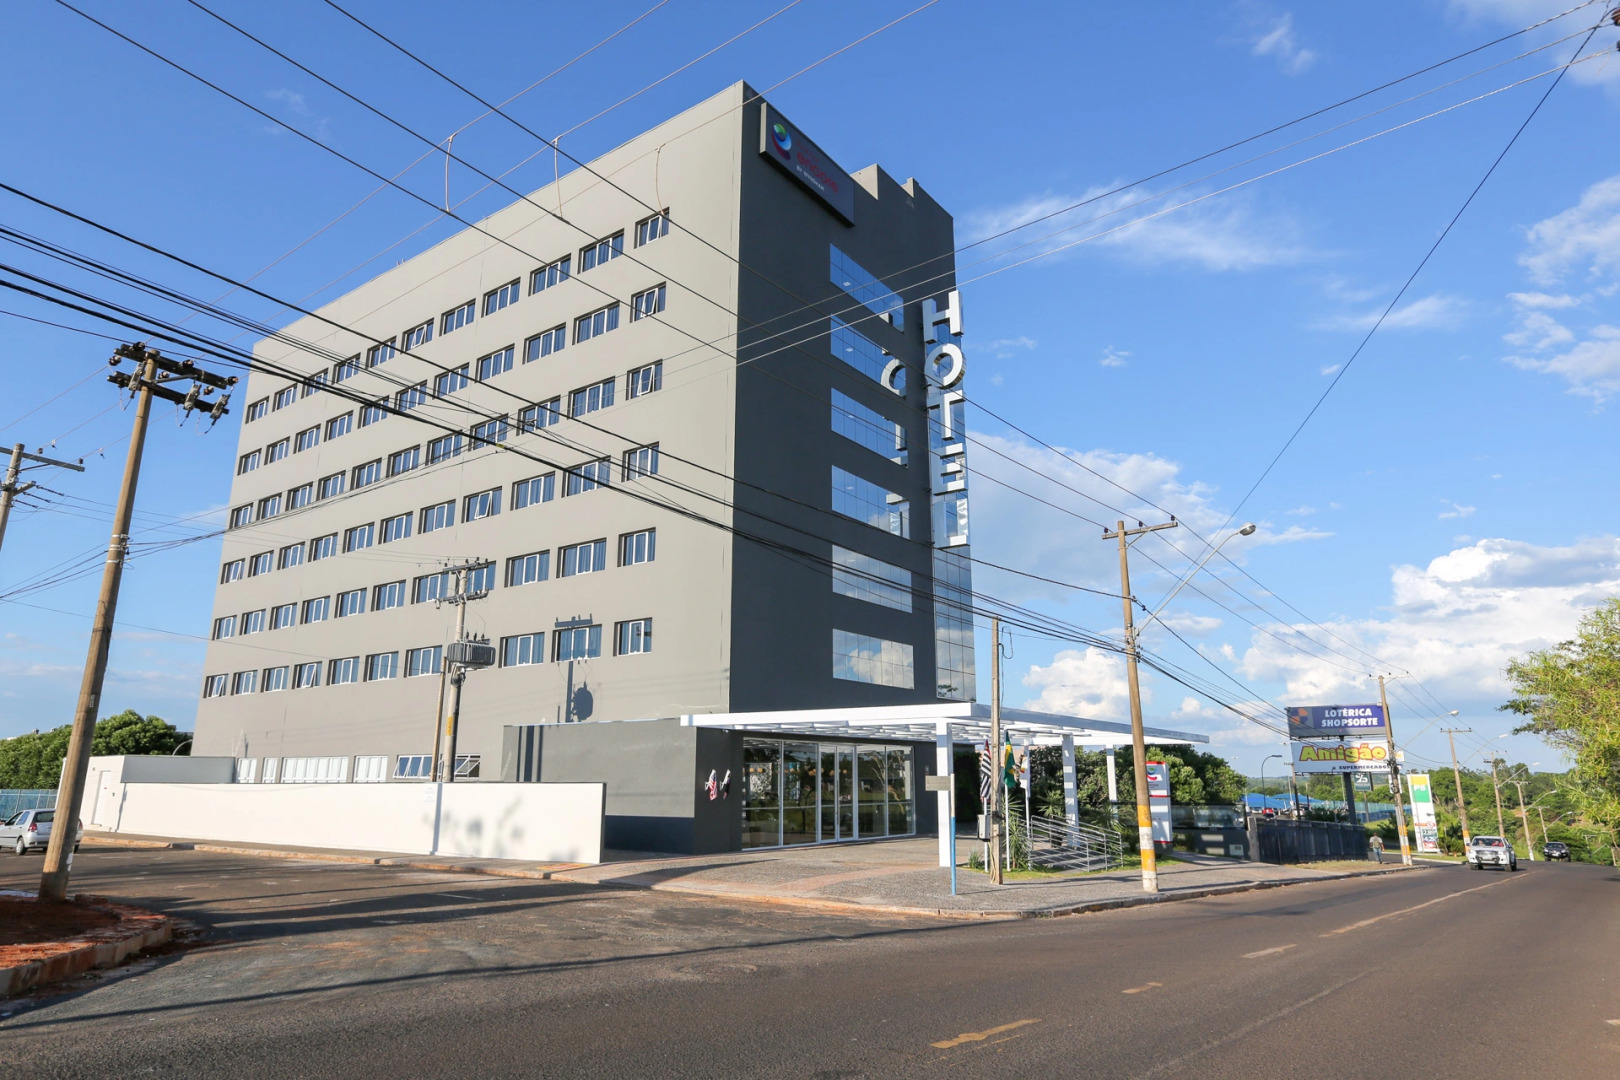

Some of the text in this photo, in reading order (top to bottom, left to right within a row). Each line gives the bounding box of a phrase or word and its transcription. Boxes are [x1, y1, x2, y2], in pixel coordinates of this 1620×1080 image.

[922, 289, 969, 549] HOTEL
[1321, 717, 1378, 727] SHOPSORTE
[1299, 743, 1387, 763] Amigão
